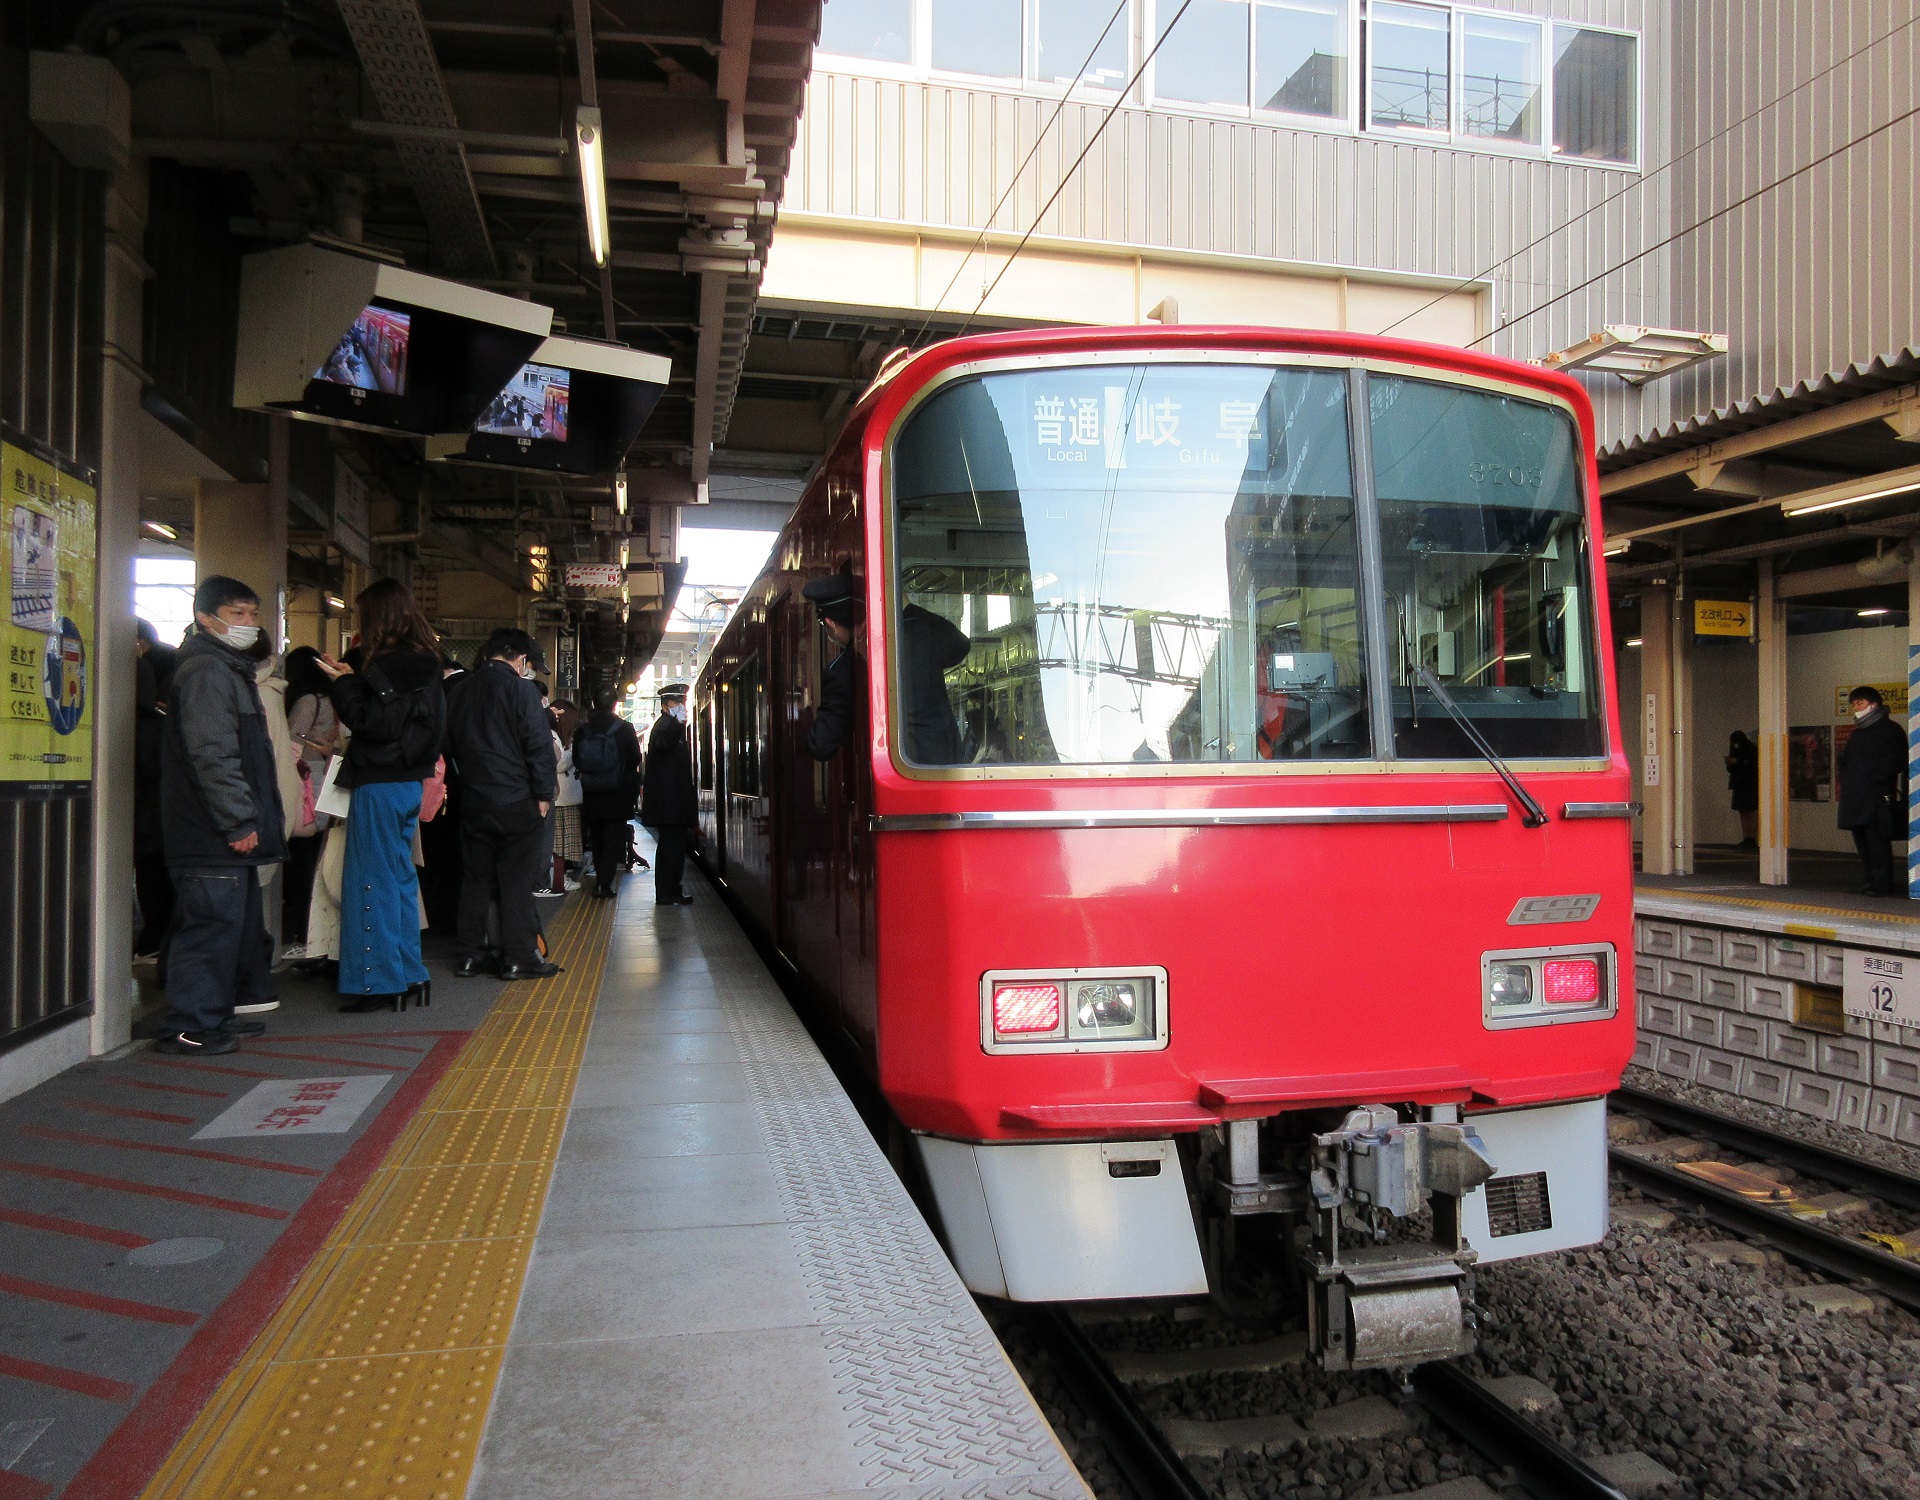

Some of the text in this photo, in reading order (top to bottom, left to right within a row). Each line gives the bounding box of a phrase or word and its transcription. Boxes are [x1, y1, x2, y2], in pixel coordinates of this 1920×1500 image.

[1034, 395, 1261, 448] 普通 岐阜
[1047, 448, 1087, 462] Local
[1179, 449, 1220, 463] Gifu
[1469, 462, 1543, 488] 3703
[1701, 609, 1732, 620] 北改札口
[565, 652, 573, 687] エレベーター
[11, 672, 35, 690] 押して
[1864, 957, 1902, 974] 乗車位置
[1872, 985, 1893, 1012] 12
